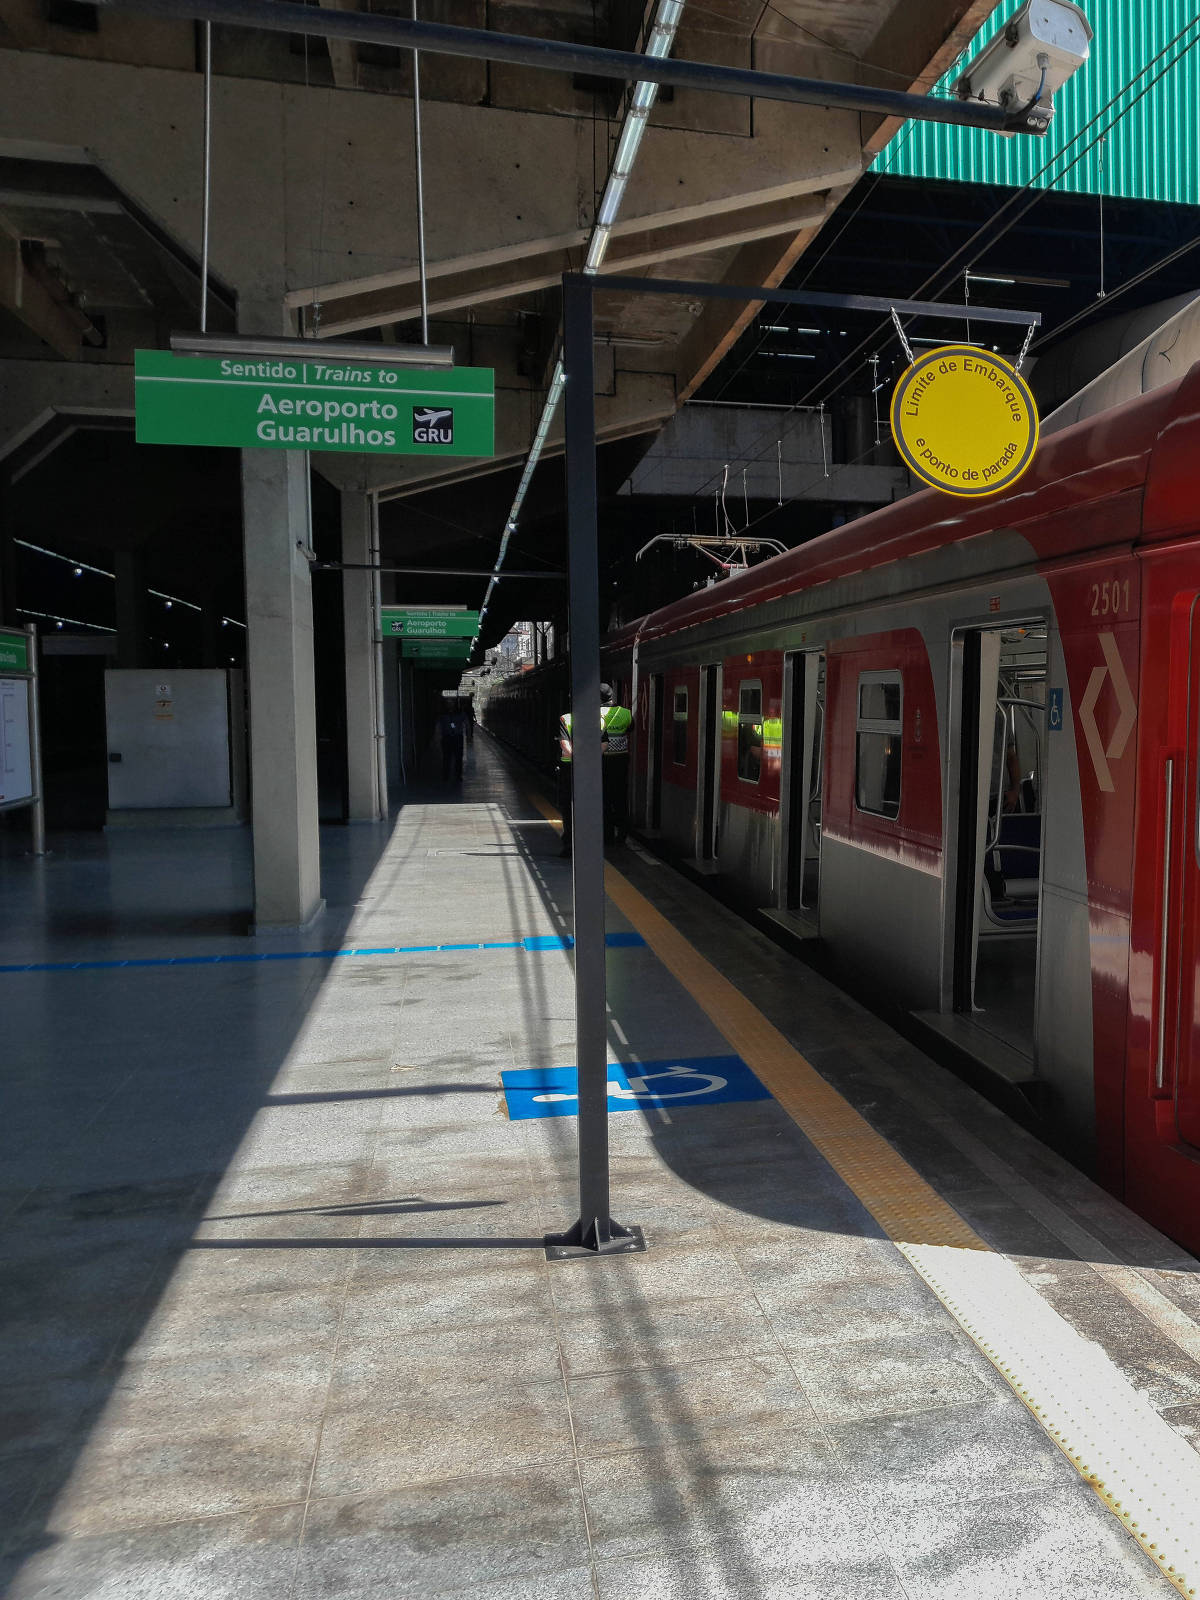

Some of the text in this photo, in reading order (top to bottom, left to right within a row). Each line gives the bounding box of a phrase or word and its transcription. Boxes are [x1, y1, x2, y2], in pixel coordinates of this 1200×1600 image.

[220, 360, 398, 384] Sentido Trains to
[906, 358, 1022, 423] Limite de Embarque
[257, 393, 398, 421] Aeroporto
[256, 420, 396, 447] Guarulhos
[414, 427, 452, 443] GRU
[916, 438, 1018, 482] e ponto de parada
[1091, 579, 1129, 617] 2501
[406, 619, 447, 628] Aeroporto
[406, 627, 447, 635] Guarulhos
